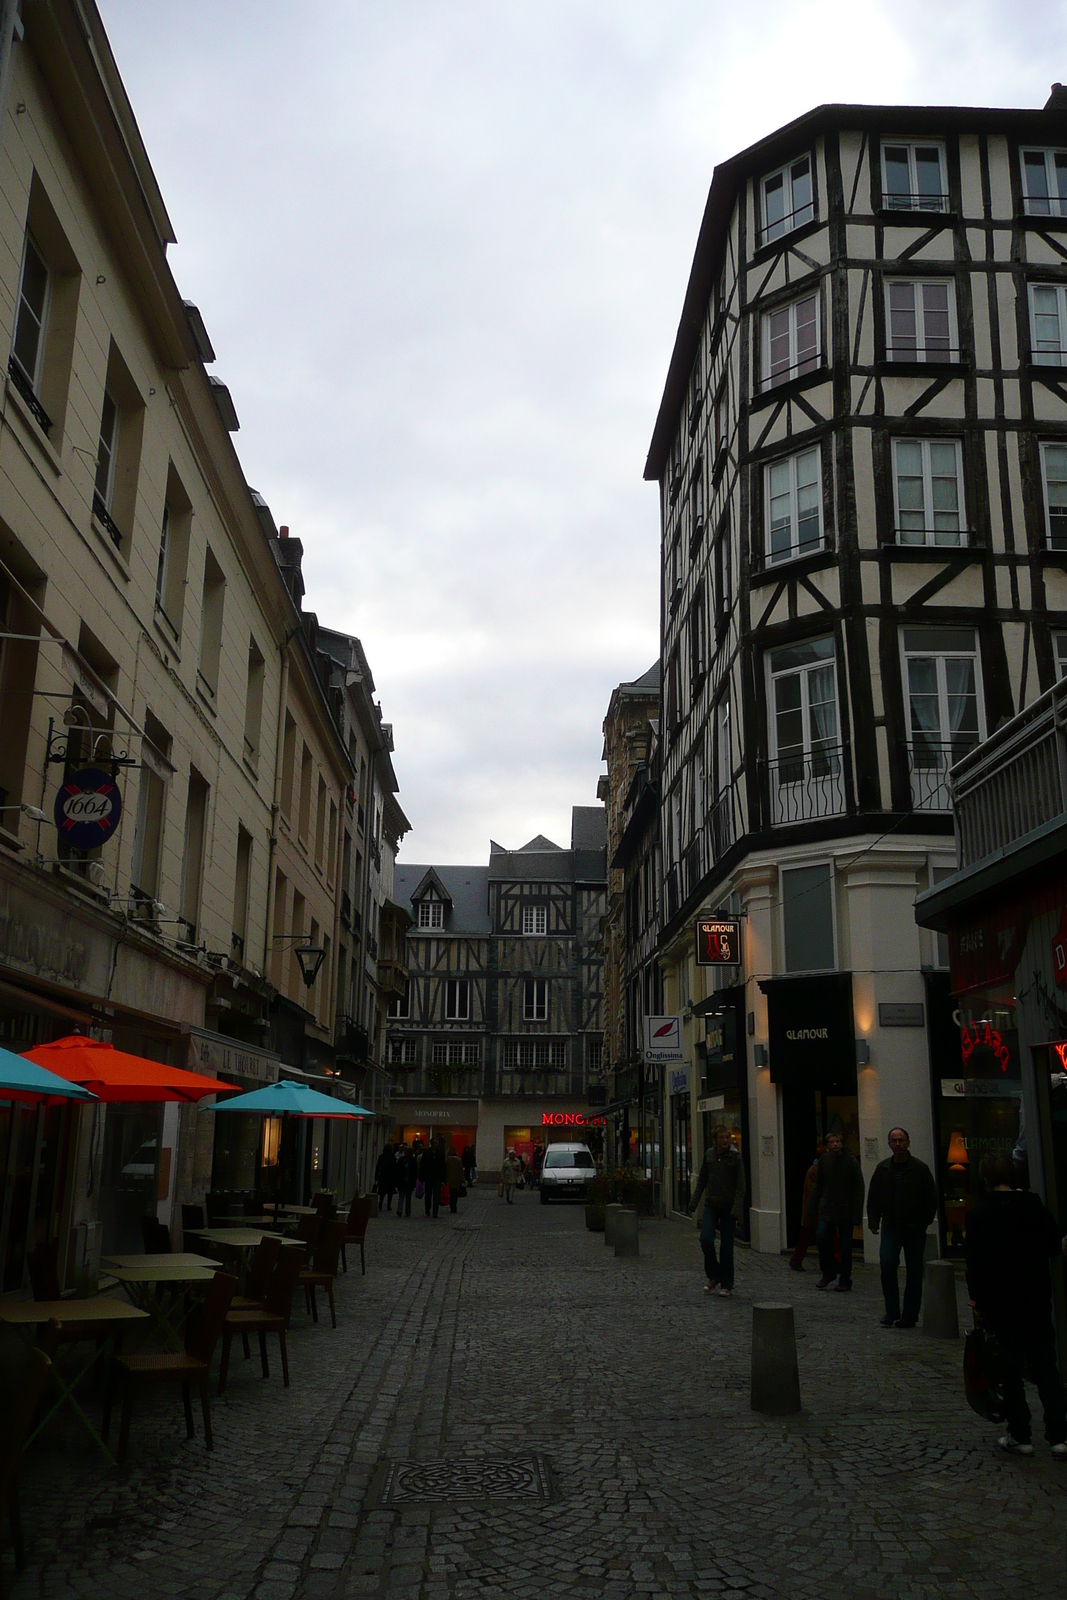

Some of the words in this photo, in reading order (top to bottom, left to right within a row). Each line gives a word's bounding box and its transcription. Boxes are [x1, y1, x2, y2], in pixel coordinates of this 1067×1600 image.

[66, 796, 109, 816] 1664
[702, 925, 735, 933] GLAMOUR
[786, 1027, 829, 1041] GLAMOUR
[645, 1050, 684, 1060] Onglissima
[414, 1110, 451, 1118] MONOPRIX
[956, 1136, 1013, 1150] GLAMOUR
